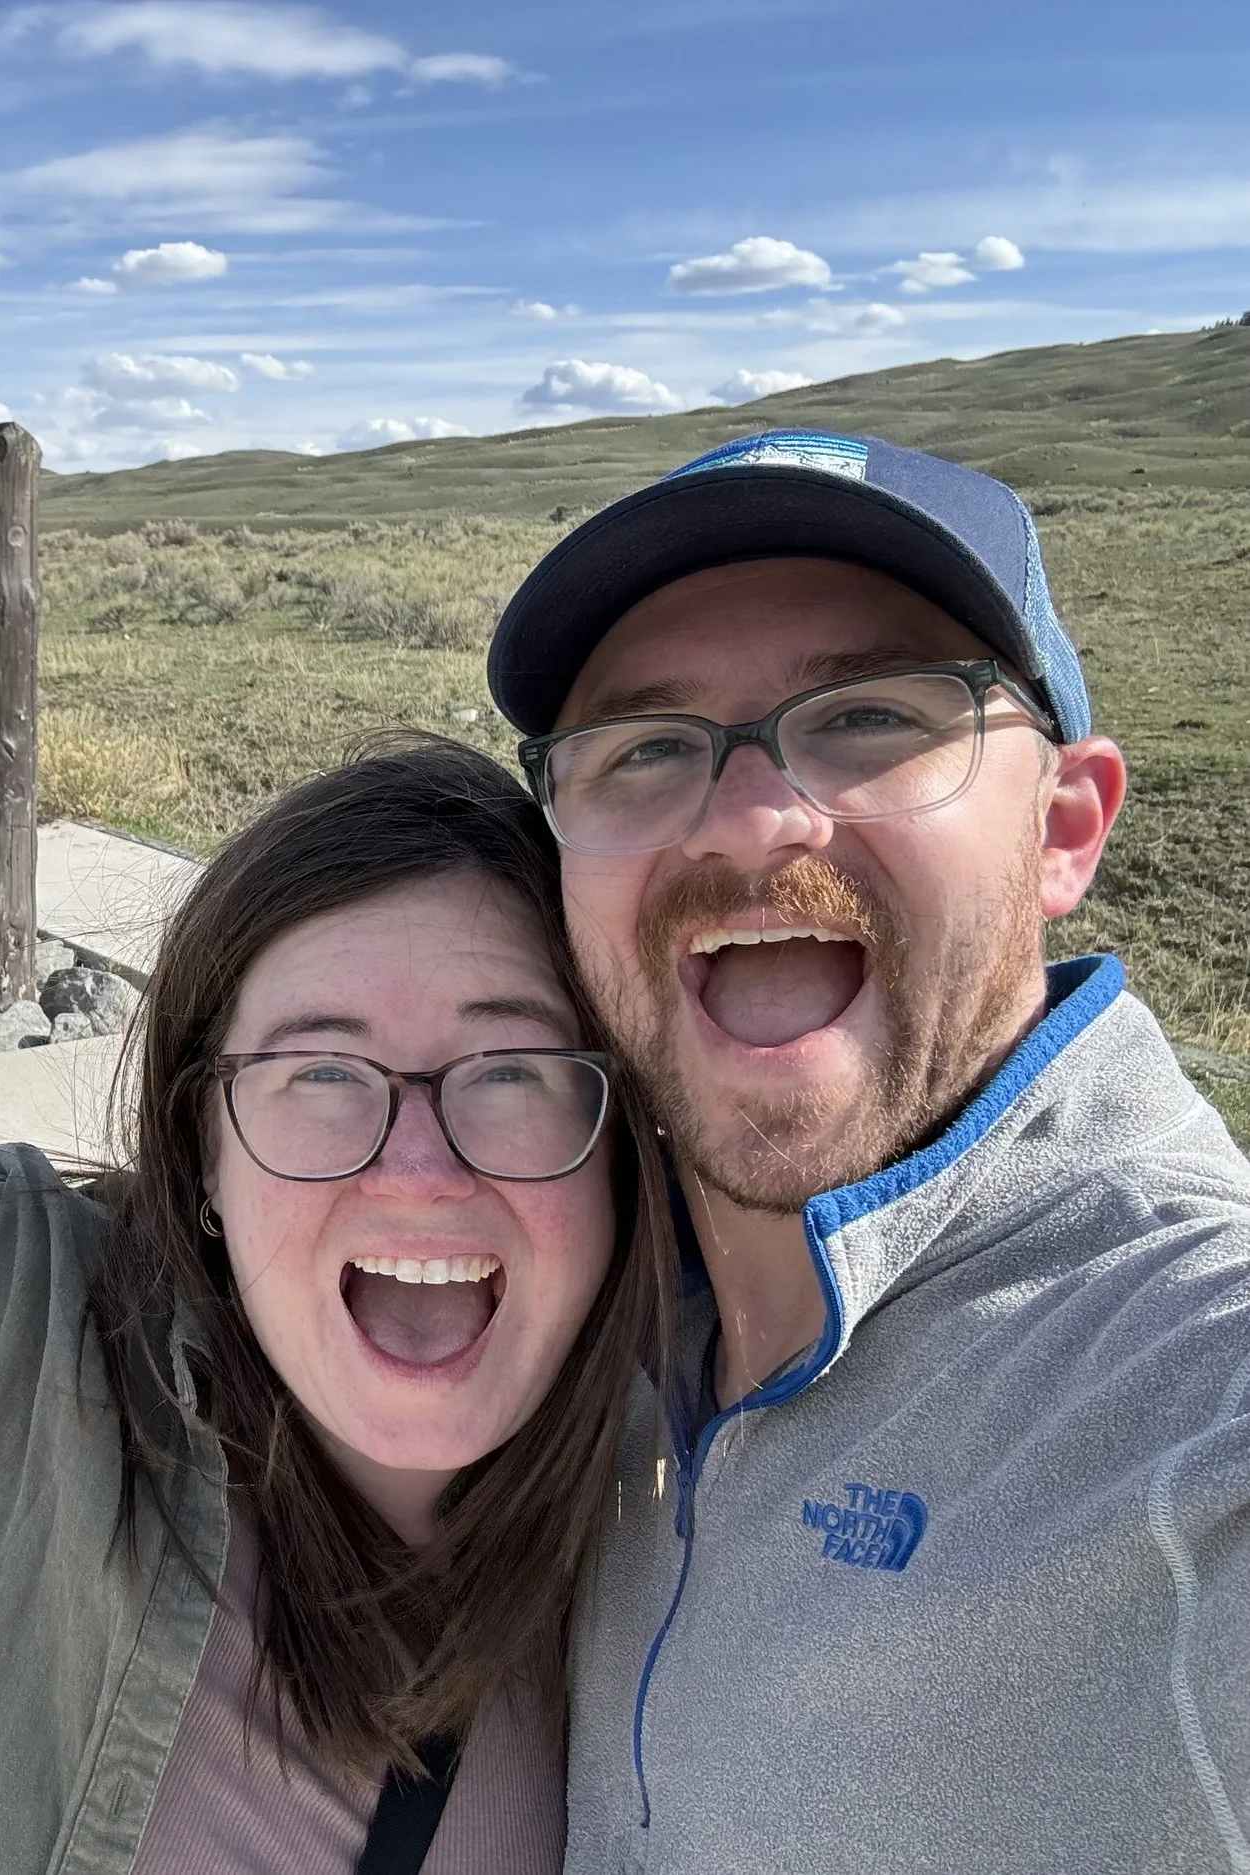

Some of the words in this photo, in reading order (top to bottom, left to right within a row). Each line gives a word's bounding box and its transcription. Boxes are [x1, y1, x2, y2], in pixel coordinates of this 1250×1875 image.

[845, 1482, 901, 1517] THE
[803, 1500, 892, 1545] NORTH
[822, 1533, 883, 1569] FACE
